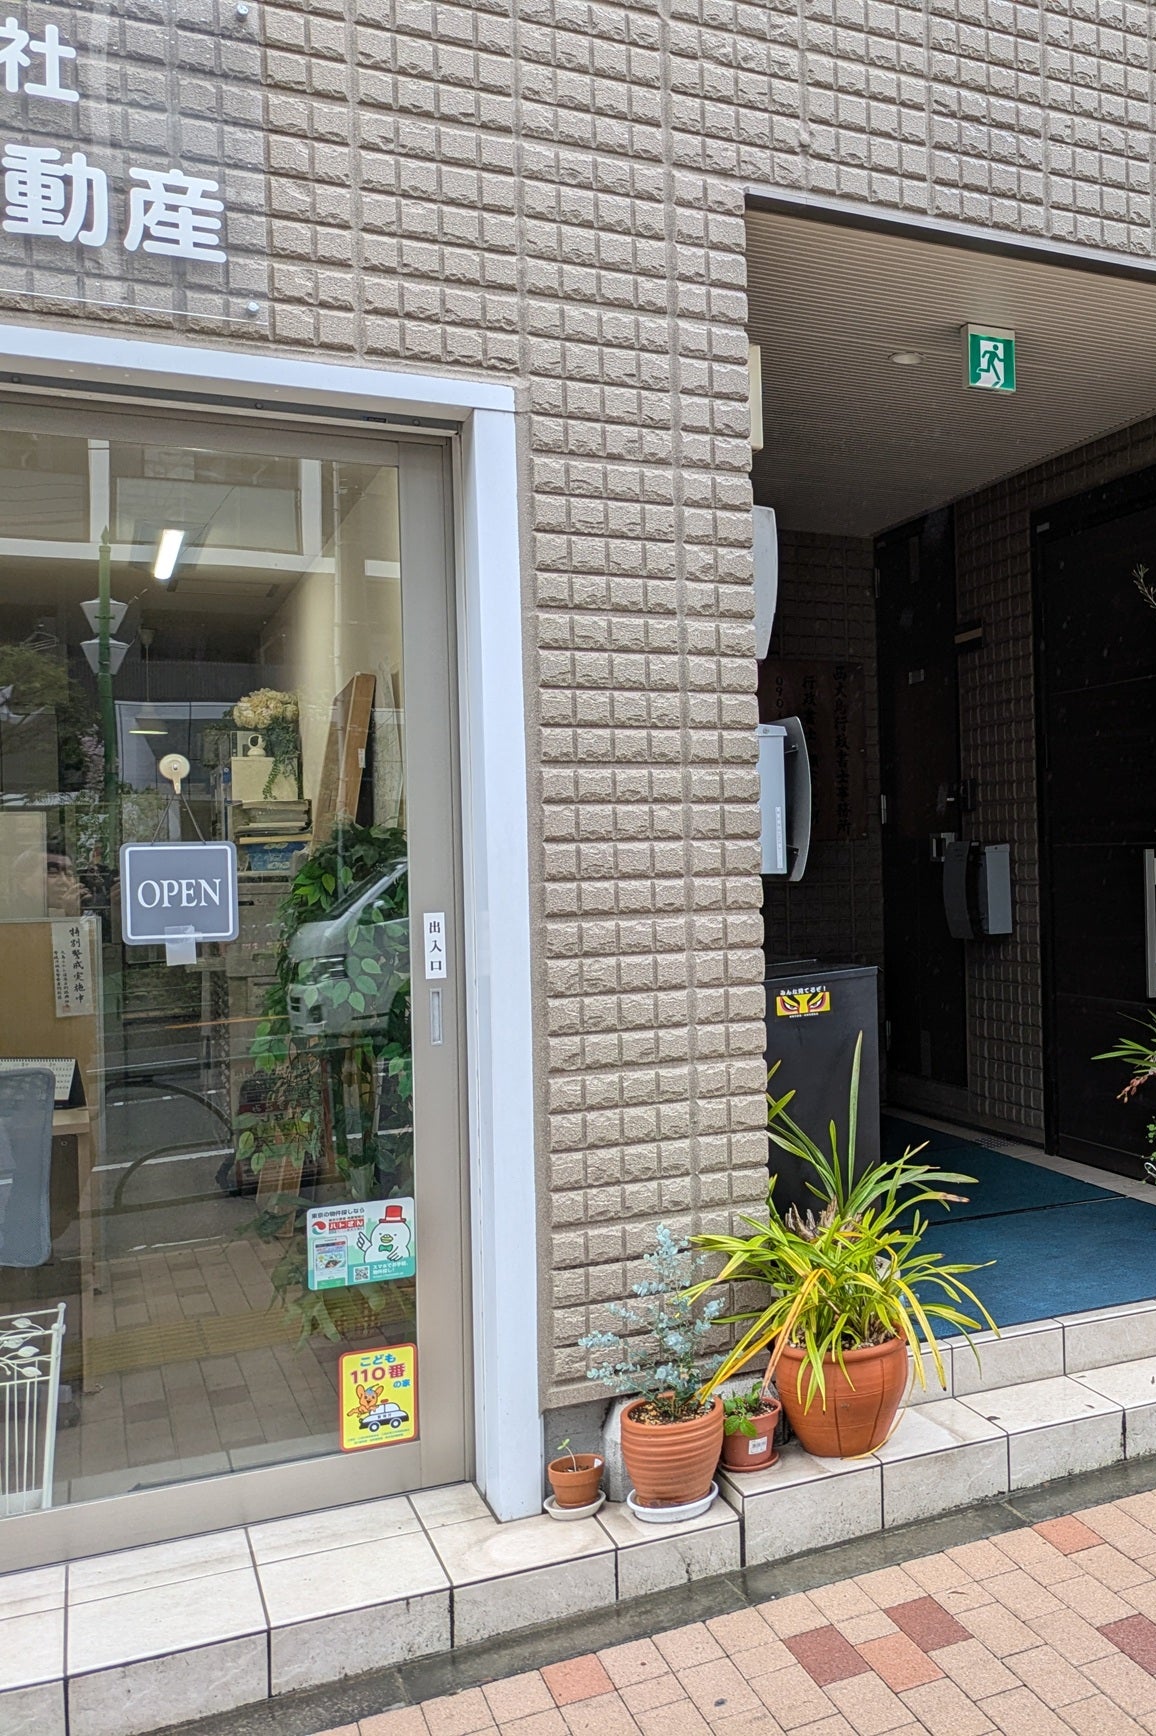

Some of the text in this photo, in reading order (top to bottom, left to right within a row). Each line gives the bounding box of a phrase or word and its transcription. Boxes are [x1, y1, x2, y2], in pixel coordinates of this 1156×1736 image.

[0, 16, 80, 103] 社
[1, 143, 228, 264] 動産
[137, 878, 222, 908] OPEN
[69, 926, 86, 1004] 特別警戒実施中
[429, 920, 442, 971] 出入口
[311, 1207, 365, 1219] 東京の物件探しなら
[350, 1362, 406, 1384] 110番
[360, 1353, 397, 1367] こども
